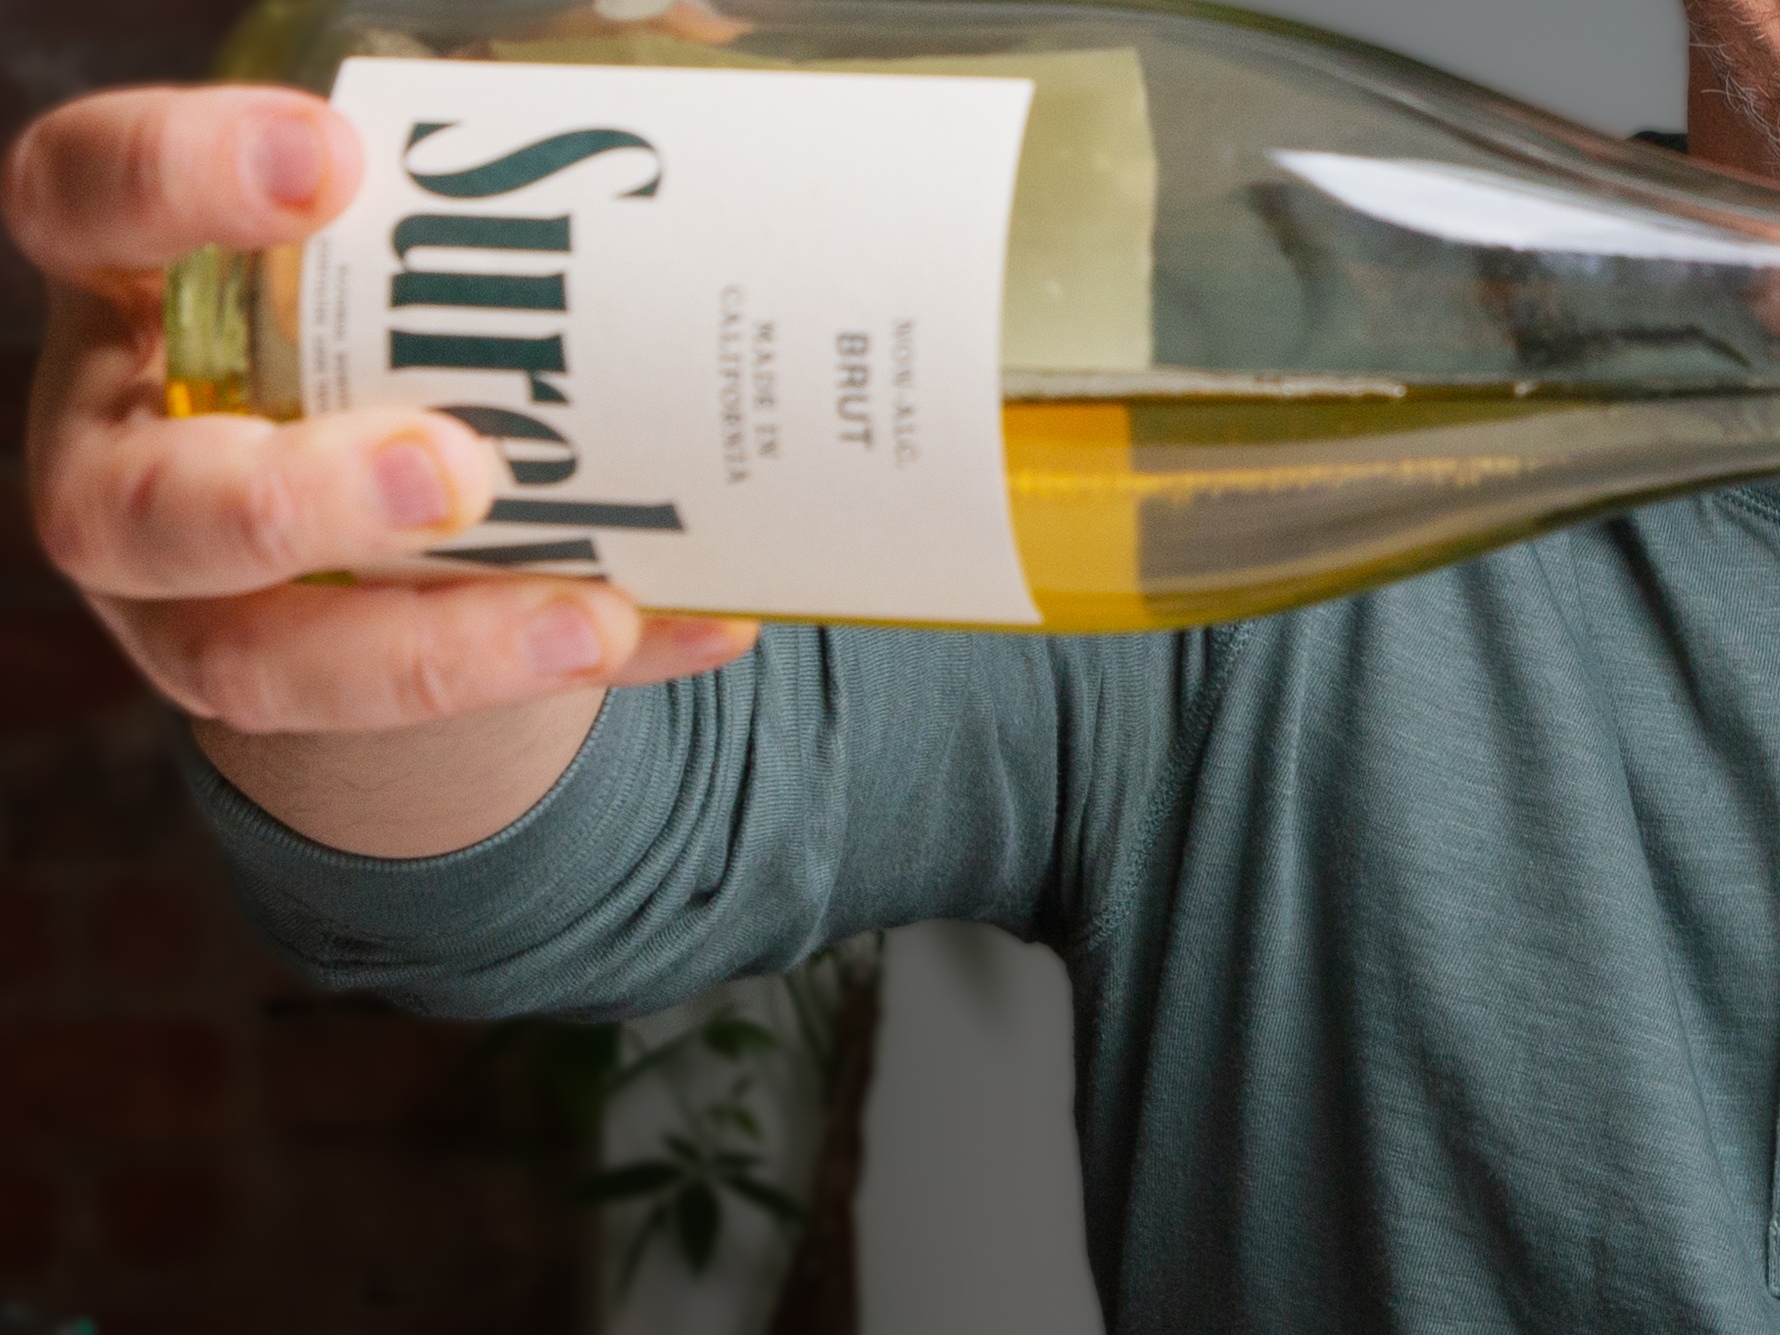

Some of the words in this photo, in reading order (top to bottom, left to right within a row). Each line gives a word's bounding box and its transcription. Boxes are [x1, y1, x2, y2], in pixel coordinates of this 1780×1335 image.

[720, 285, 750, 485] CALIFORNIA
[754, 322, 778, 410] MADE
[836, 333, 873, 450] BRUT
[755, 424, 779, 458] IN
